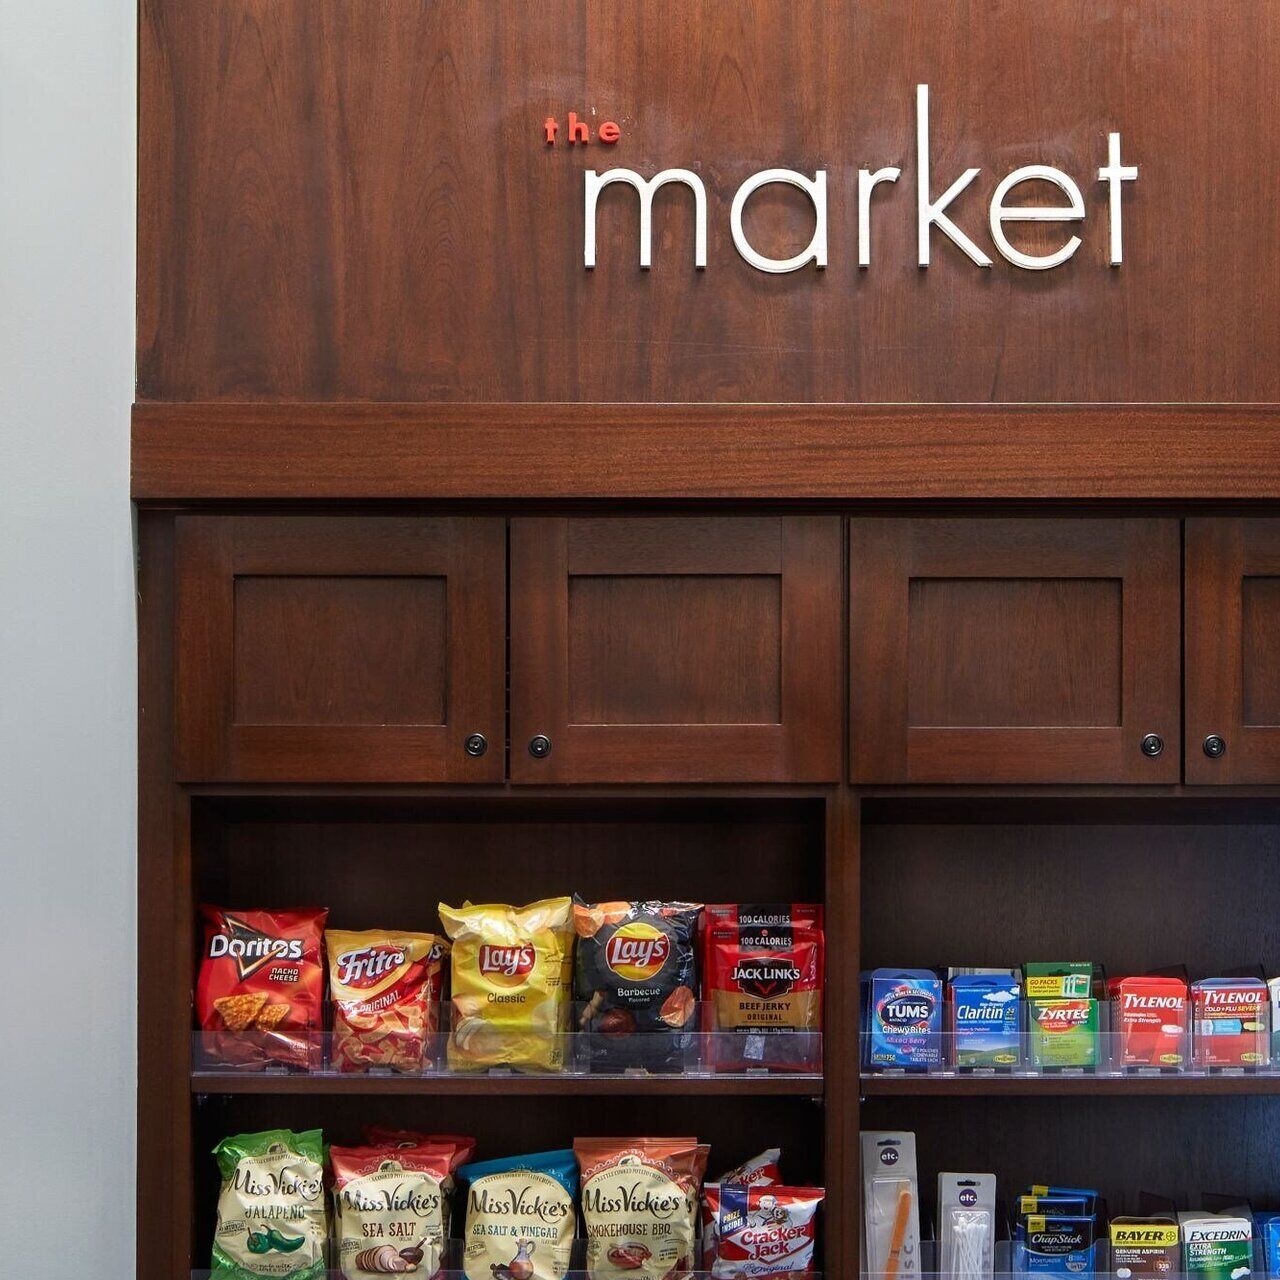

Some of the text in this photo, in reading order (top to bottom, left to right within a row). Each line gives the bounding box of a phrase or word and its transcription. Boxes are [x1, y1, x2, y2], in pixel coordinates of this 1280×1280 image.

[545, 112, 620, 144] the
[584, 83, 1139, 274] market
[739, 915, 790, 924] 100 CALORIES
[210, 934, 302, 958] Doritos
[740, 937, 792, 946] 100 CALORIES
[611, 937, 666, 967] Lay's
[483, 944, 532, 976] Lay's
[268, 974, 299, 982] CHEESE
[271, 967, 299, 975] NACHO
[731, 968, 800, 980] JACK LINK'S
[487, 992, 526, 1004] Classic
[617, 987, 661, 997] Barbecue
[1203, 990, 1263, 1005] TYLENOL
[739, 1002, 791, 1011] BEEF JERKY
[1123, 993, 1184, 1009] TYLENOL
[747, 1013, 782, 1021] ORIGINAL
[887, 1005, 929, 1018] TUMS
[957, 1005, 1003, 1019] Claritin
[1038, 1007, 1090, 1020] ZYRTEC
[882, 1026, 931, 1036] Chewy Bites
[881, 1151, 899, 1159] etc.
[228, 1168, 271, 1195] Miss
[343, 1183, 439, 1217] Miss Vickie's
[584, 1188, 621, 1213] Miss
[618, 1182, 679, 1219] Vickie's
[960, 1193, 977, 1202] etc.
[470, 1186, 568, 1224] Miss Vickie's
[723, 1209, 740, 1223] PRIZE
[362, 1222, 417, 1237] SEA SALT
[472, 1224, 558, 1239] SEA SALT & VINEGAR
[587, 1223, 671, 1238] SMOKEHOUSE BBQ
[740, 1226, 806, 1246] Cracker
[1115, 1231, 1164, 1241] BAYER
[1189, 1230, 1250, 1241] EXCEDRIN
[1032, 1234, 1082, 1244] ChapStick
[749, 1242, 790, 1260] Jack
[751, 1260, 794, 1275] Original
